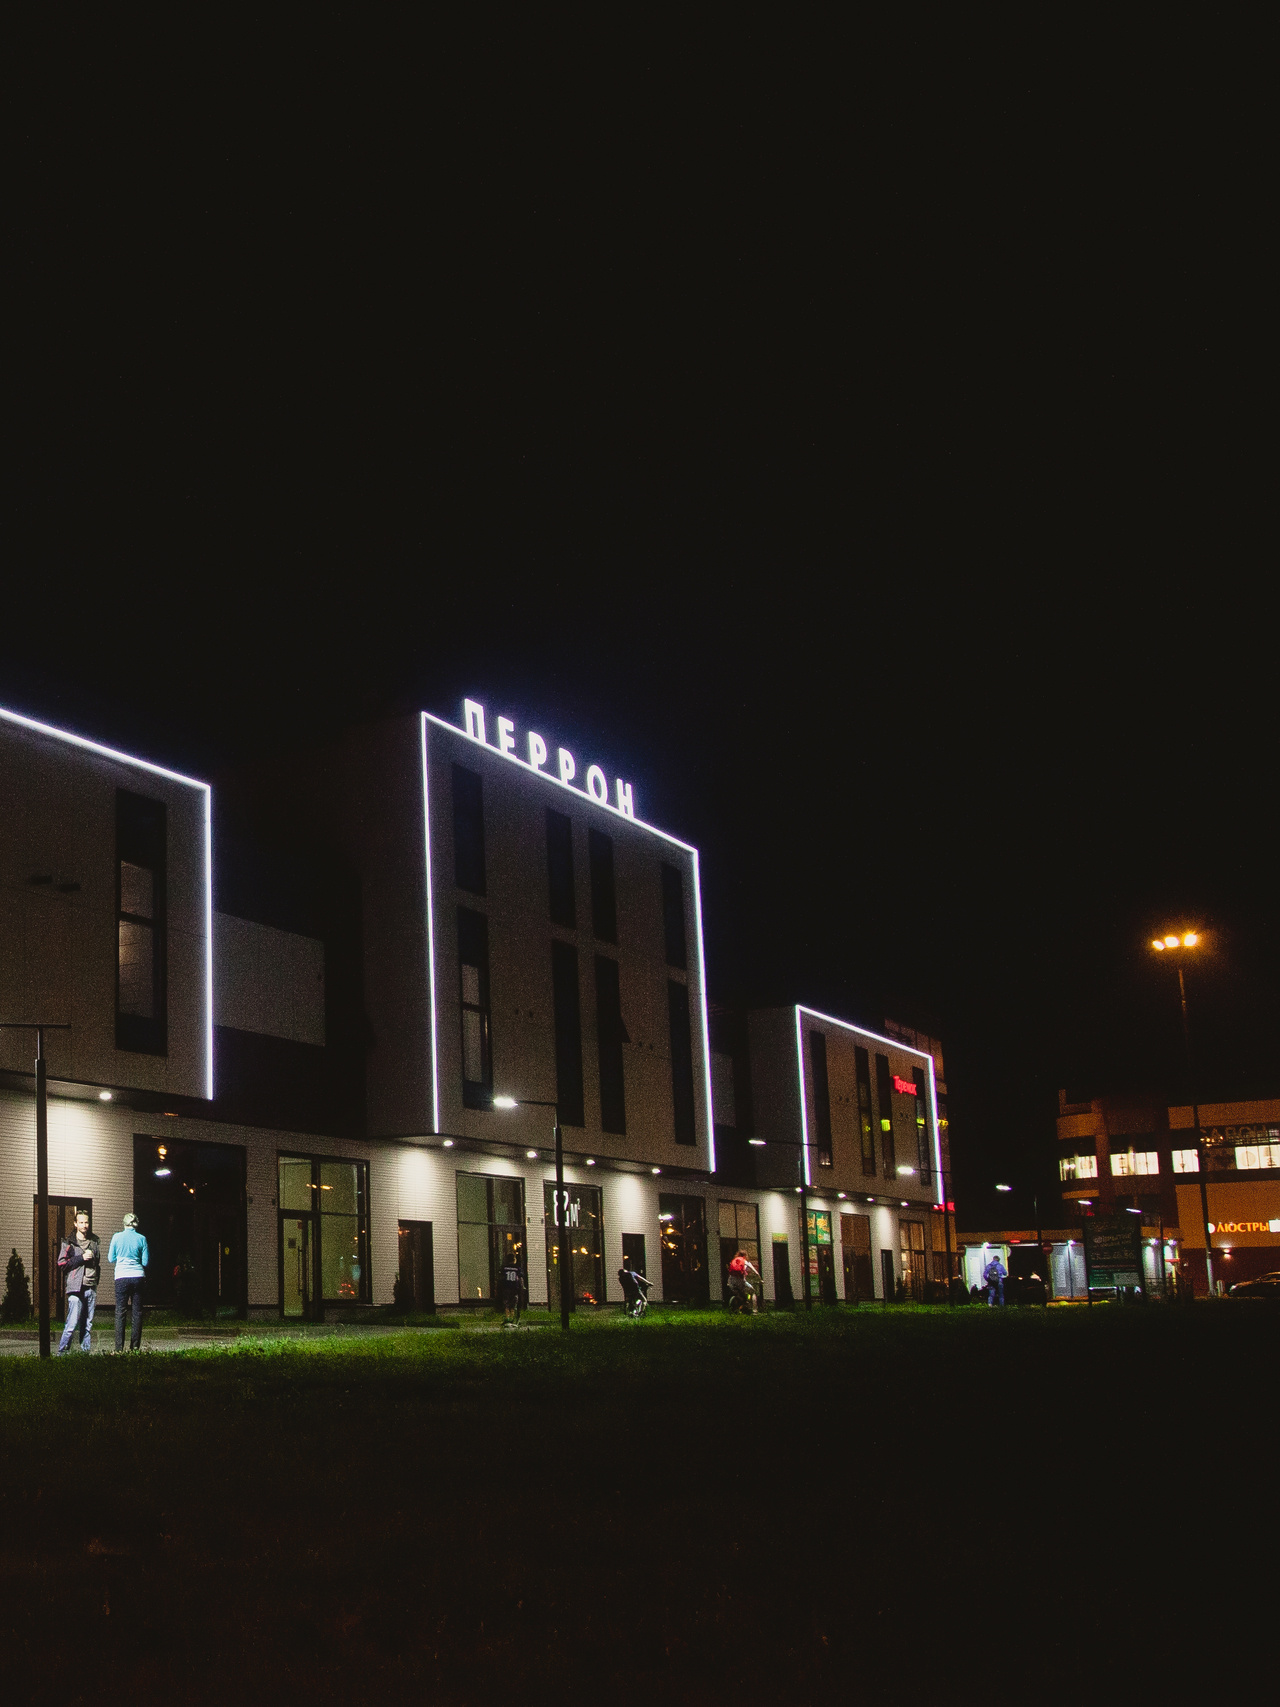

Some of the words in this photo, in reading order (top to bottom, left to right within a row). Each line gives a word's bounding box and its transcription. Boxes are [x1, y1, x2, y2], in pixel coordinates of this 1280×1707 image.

[464, 698, 635, 819] ПЕРРОН
[1216, 1222, 1270, 1233] ЛЮСТРЫ
[505, 1270, 517, 1282] 10
